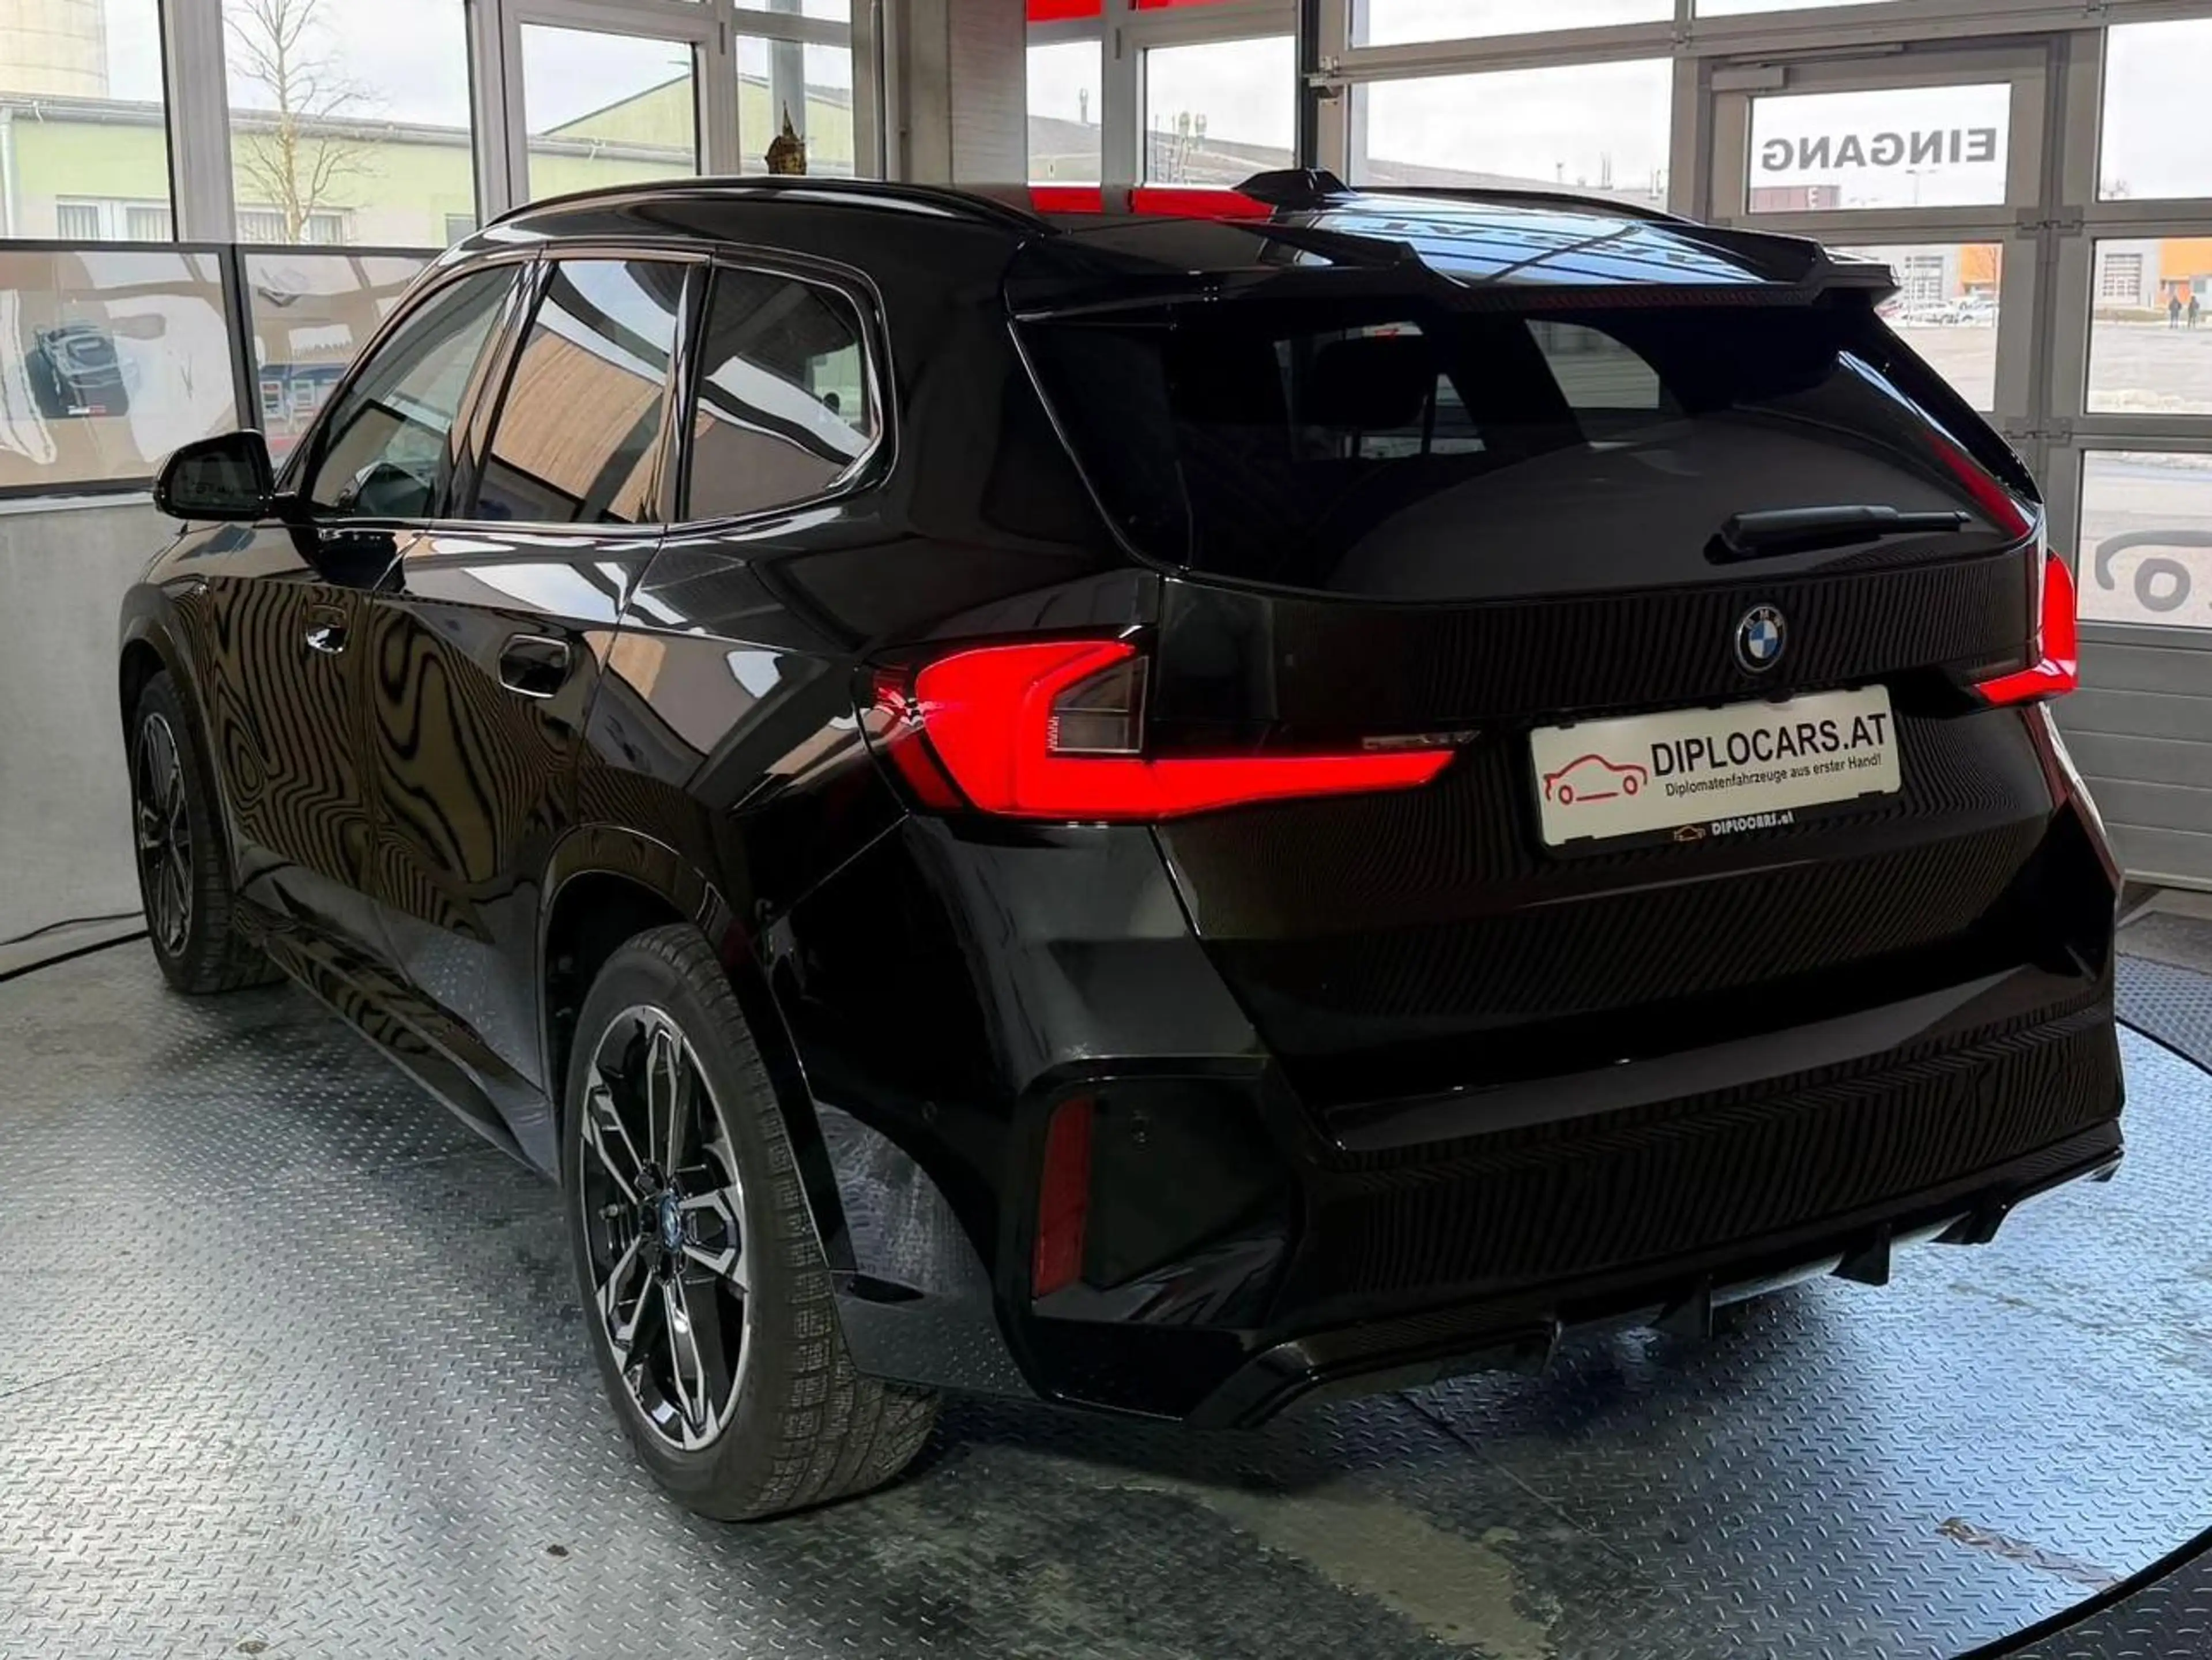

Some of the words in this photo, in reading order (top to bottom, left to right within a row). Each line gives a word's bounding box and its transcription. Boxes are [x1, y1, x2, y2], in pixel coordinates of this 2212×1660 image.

[1650, 714, 1886, 776] DIPLOCARS.AT
[1665, 769, 1787, 797] Diplomatenfahrzeuge
[1791, 765, 1811, 778] aus
[1813, 759, 1845, 775] erster
